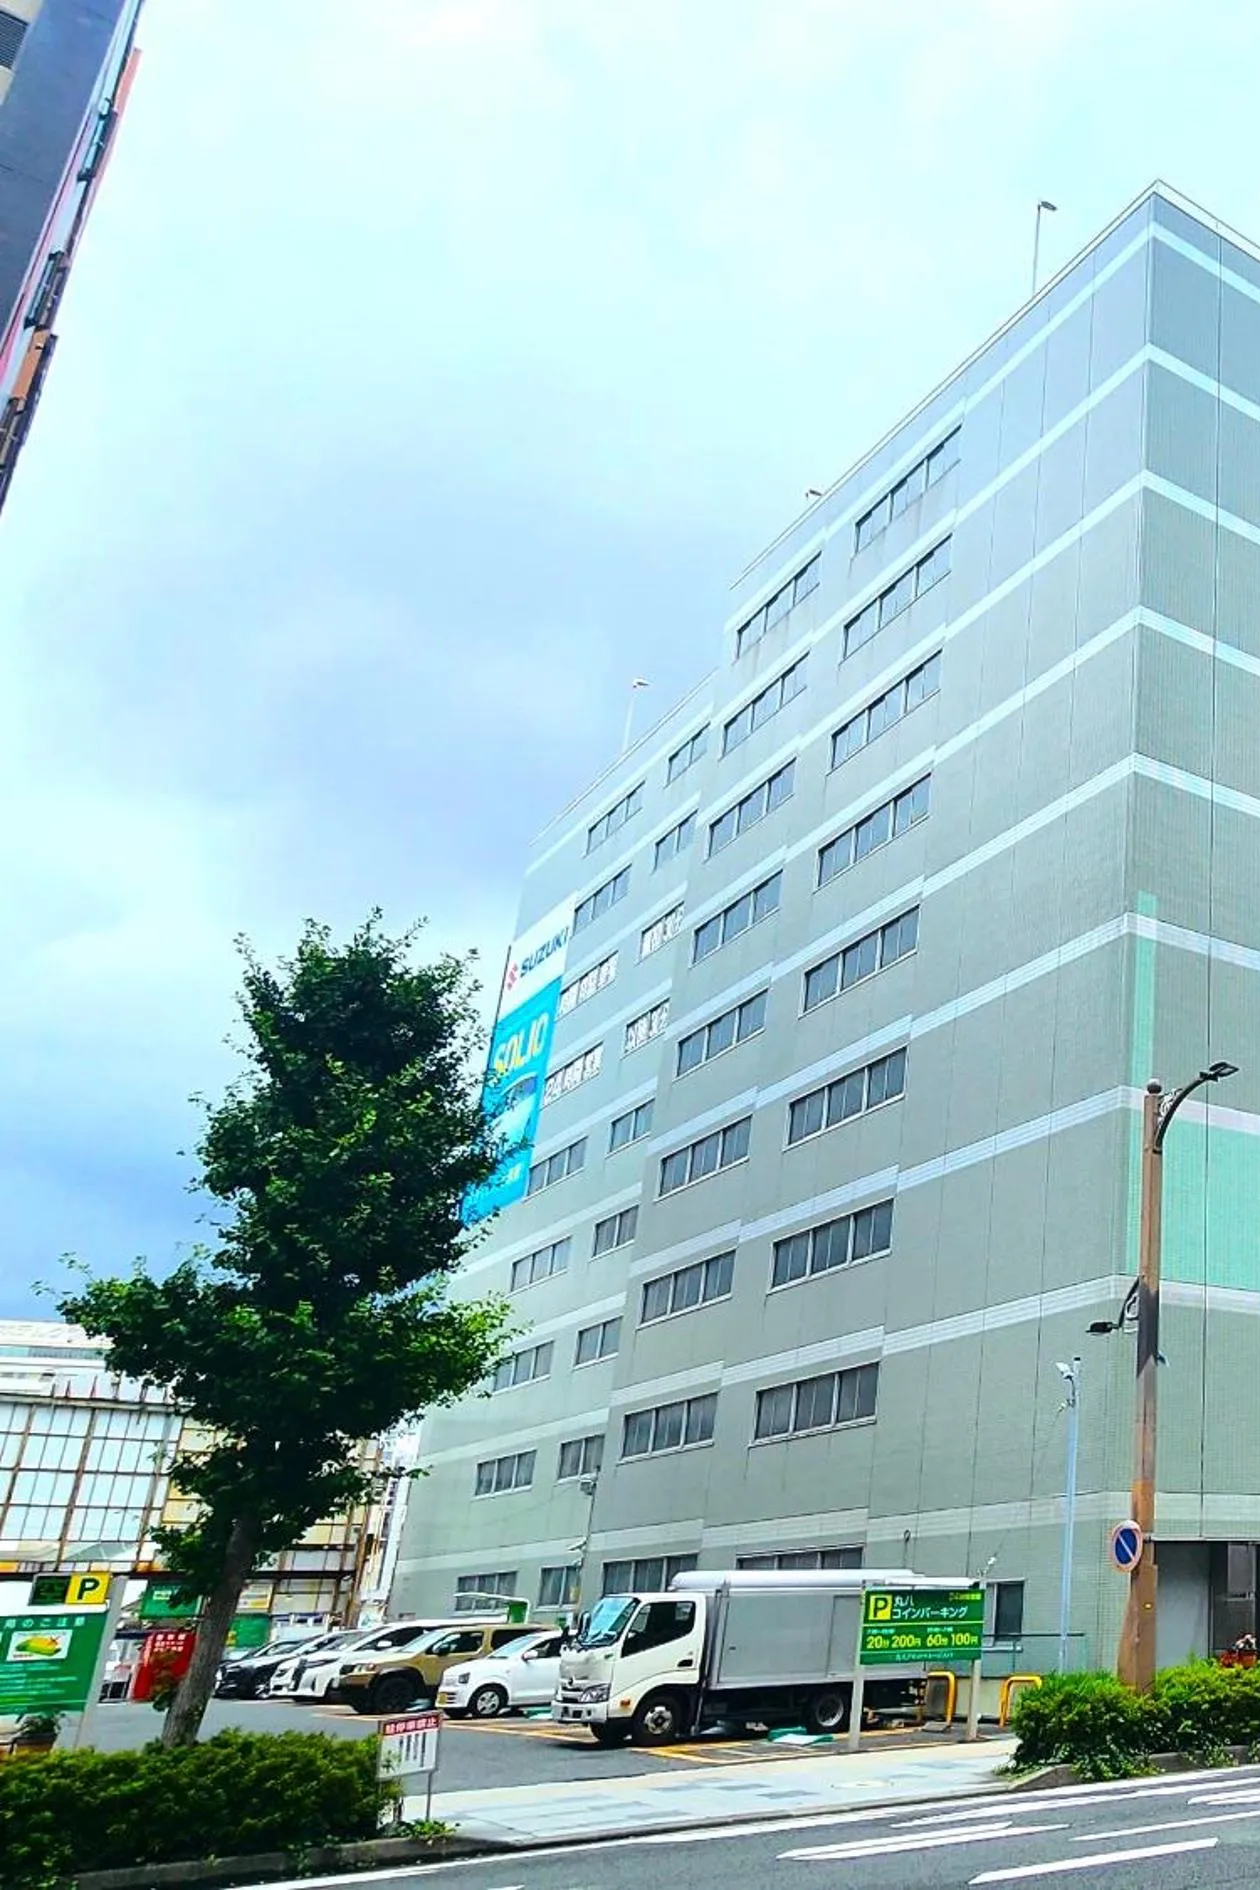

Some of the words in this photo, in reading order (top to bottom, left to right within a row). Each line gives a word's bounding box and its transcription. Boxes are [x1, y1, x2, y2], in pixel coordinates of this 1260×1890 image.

[519, 925, 570, 978] SUZUKI
[76, 1577, 100, 1601] P
[873, 1597, 888, 1619] P
